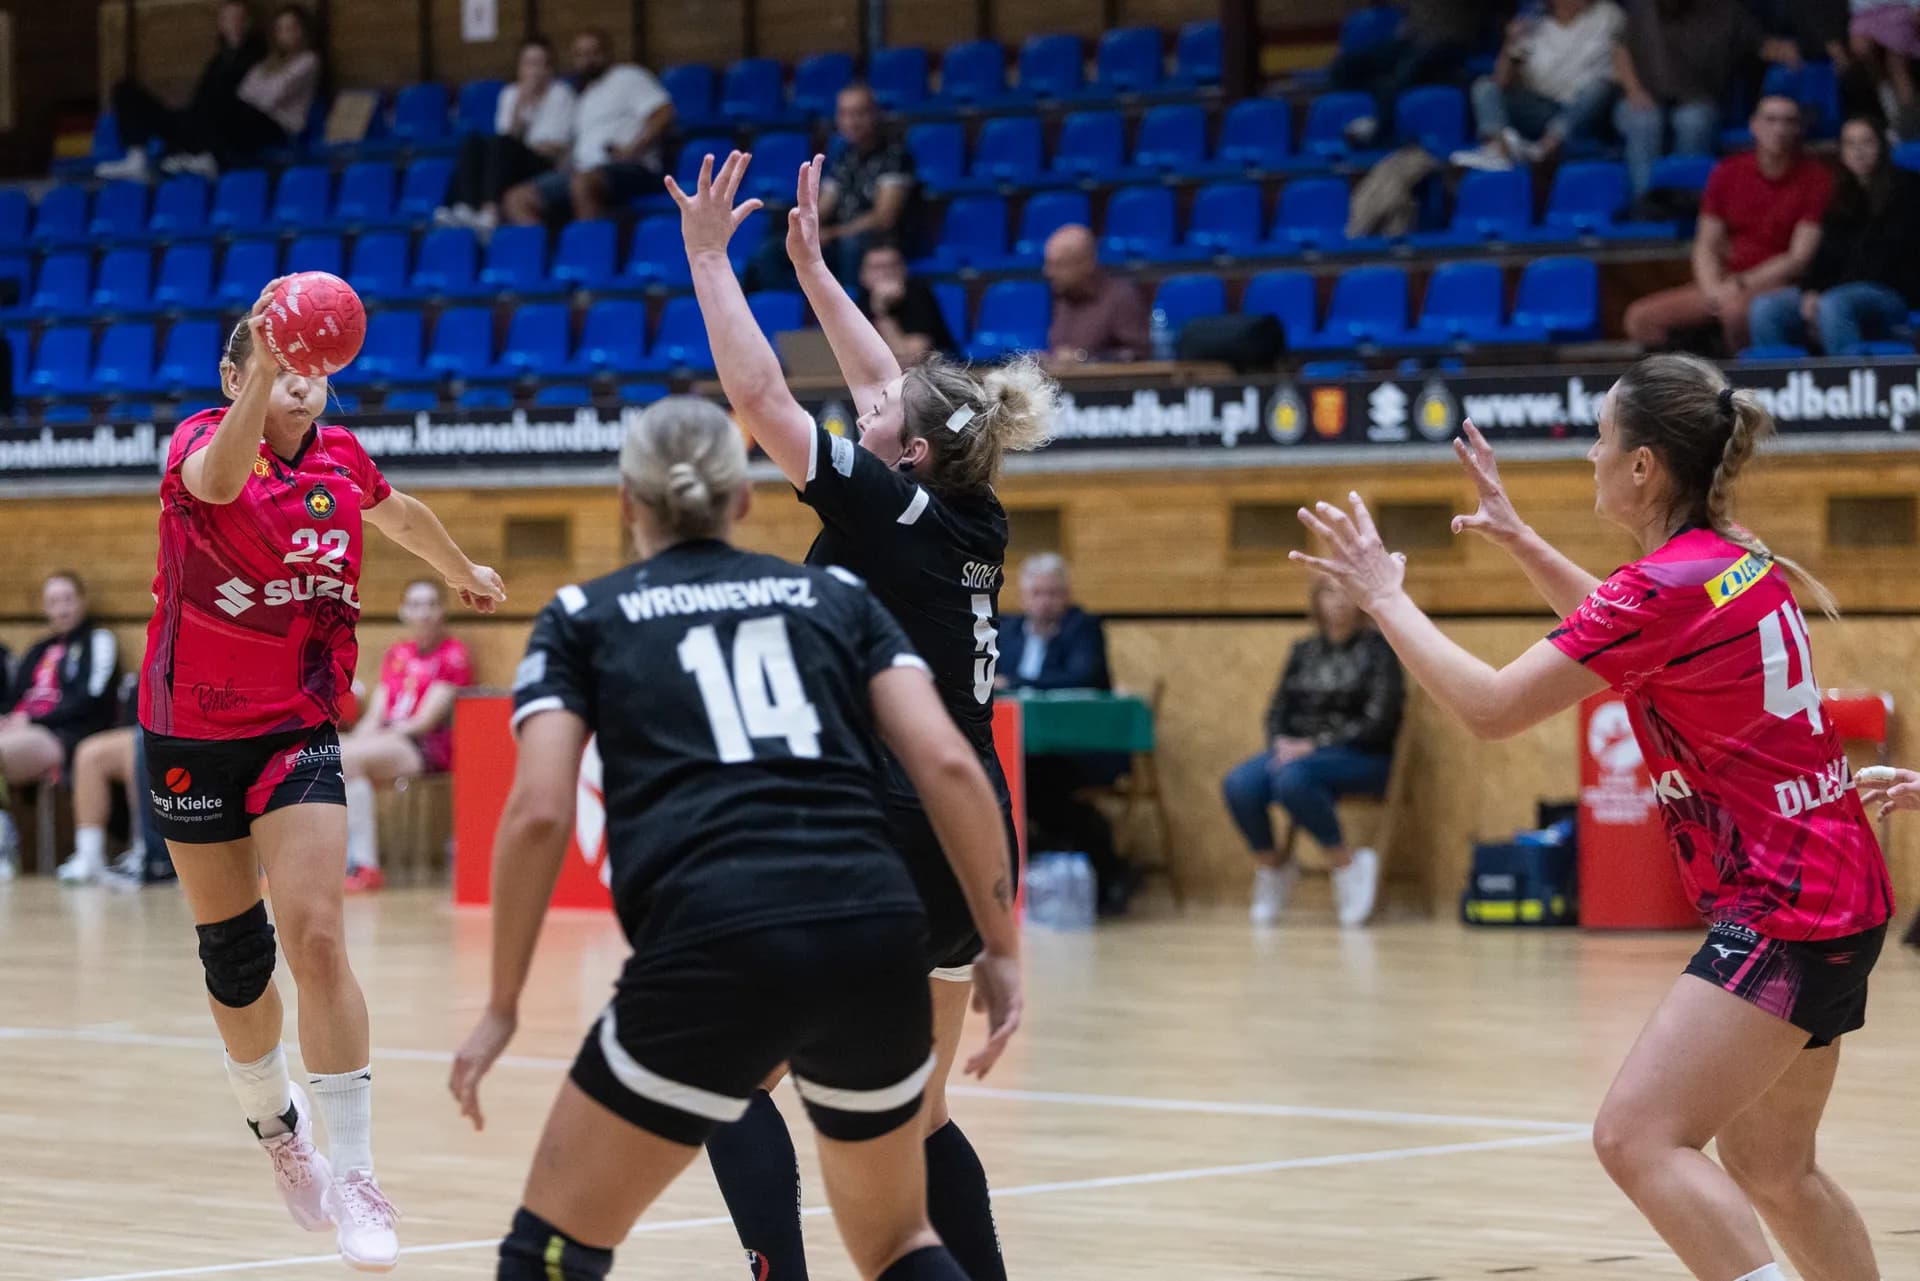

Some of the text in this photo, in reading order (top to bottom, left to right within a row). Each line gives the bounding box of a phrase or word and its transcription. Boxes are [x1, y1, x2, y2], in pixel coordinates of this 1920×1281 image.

[283, 528, 350, 573] 22
[617, 576, 817, 622] WRONIEWICZ
[677, 615, 822, 763] 14
[1758, 600, 1824, 736] 4
[150, 789, 222, 811] Targi Kielce
